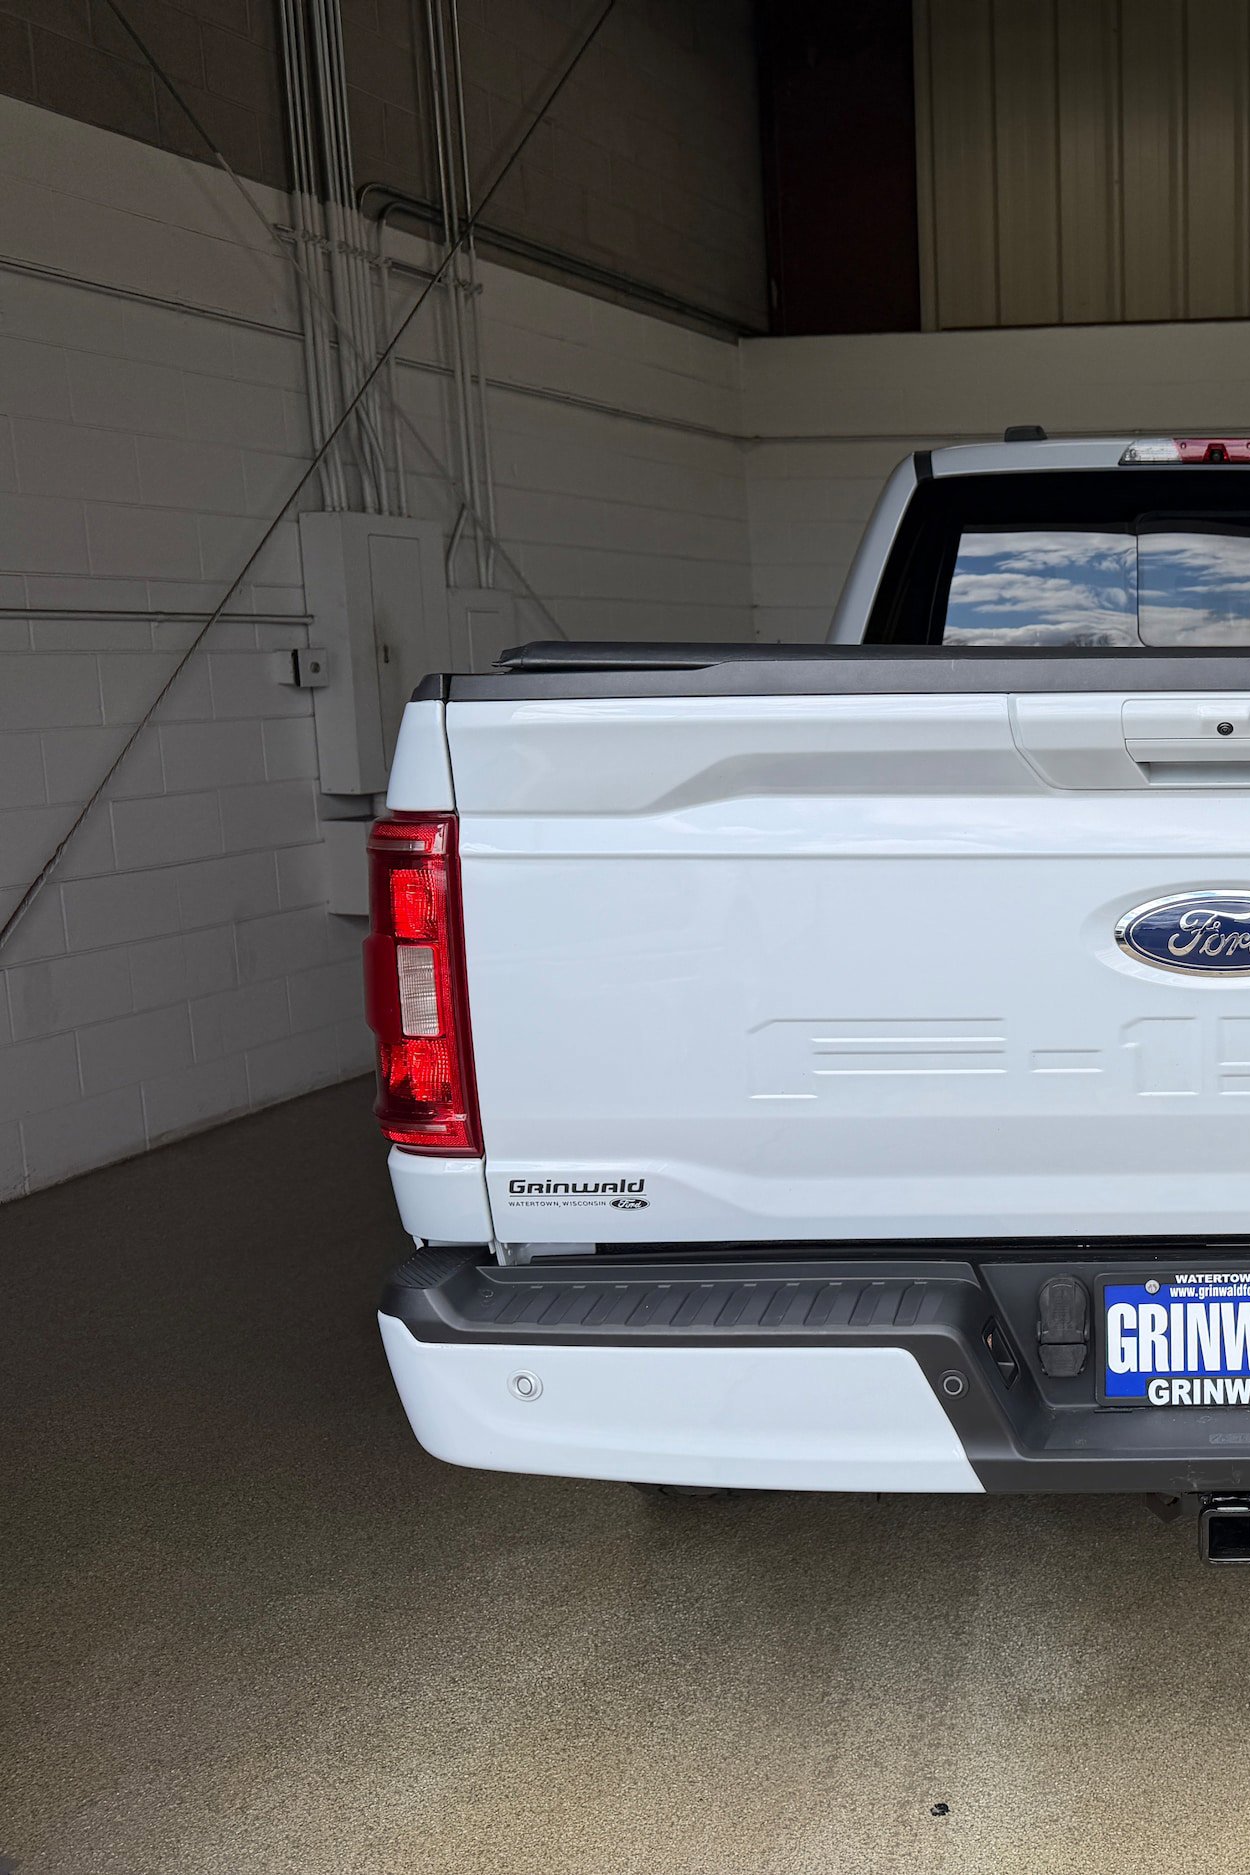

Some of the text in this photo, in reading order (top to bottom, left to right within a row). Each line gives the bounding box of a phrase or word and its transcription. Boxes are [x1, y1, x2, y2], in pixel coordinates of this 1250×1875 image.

[509, 1178, 645, 1194] Grinwald
[508, 1200, 562, 1208] WATERTOWN,
[618, 1199, 642, 1209] Ford
